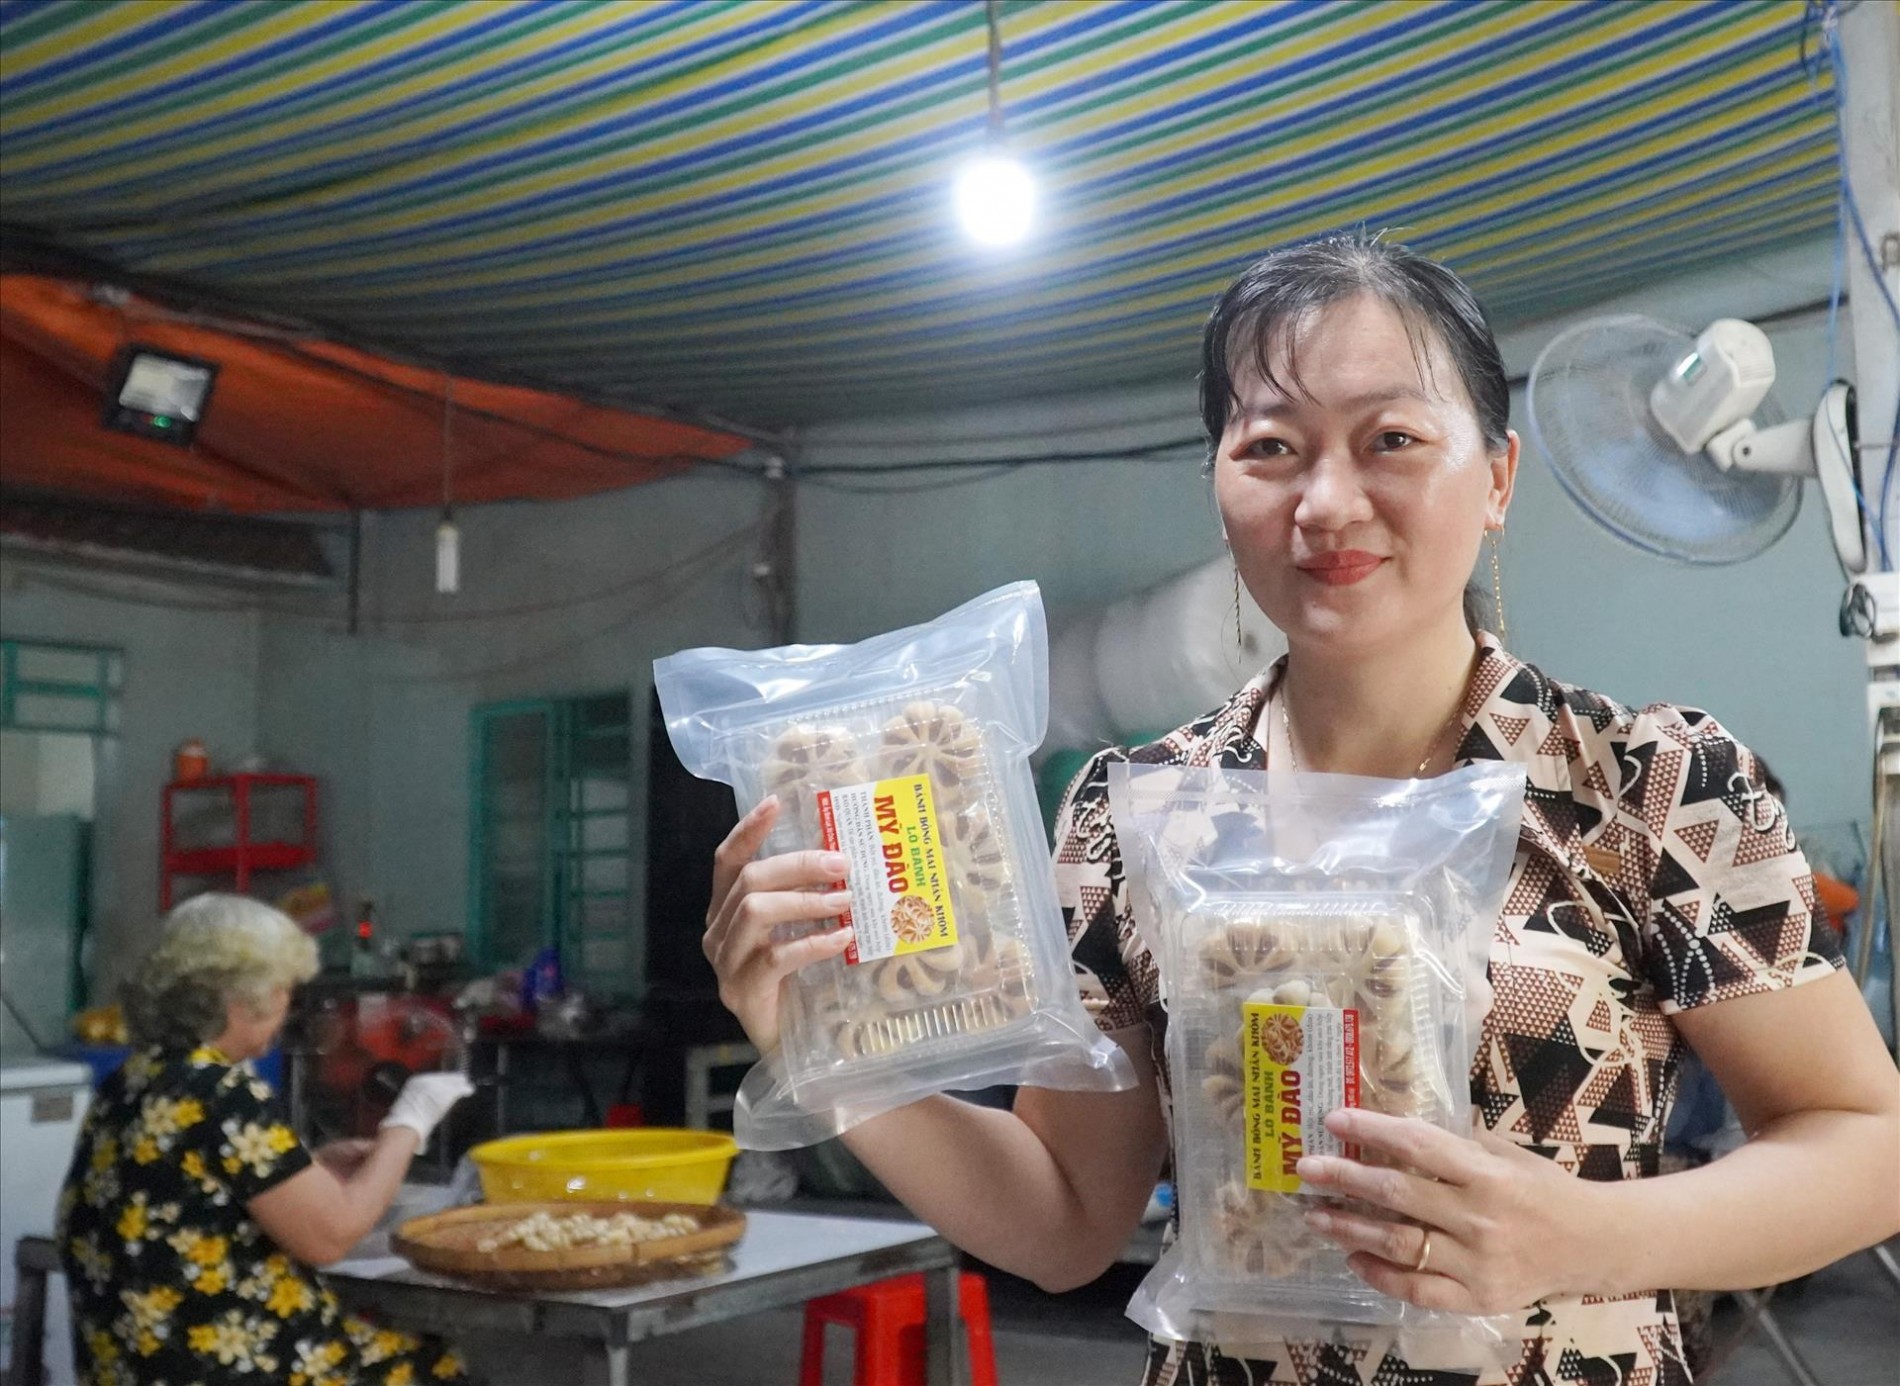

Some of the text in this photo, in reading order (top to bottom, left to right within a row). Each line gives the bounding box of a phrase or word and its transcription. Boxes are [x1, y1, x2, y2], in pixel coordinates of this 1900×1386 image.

[874, 795, 911, 894] MỸ ĐÀO
[924, 848, 936, 869] MAI
[1251, 1086, 1261, 1109] MAI
[1276, 1069, 1301, 1124] ĐÀO
